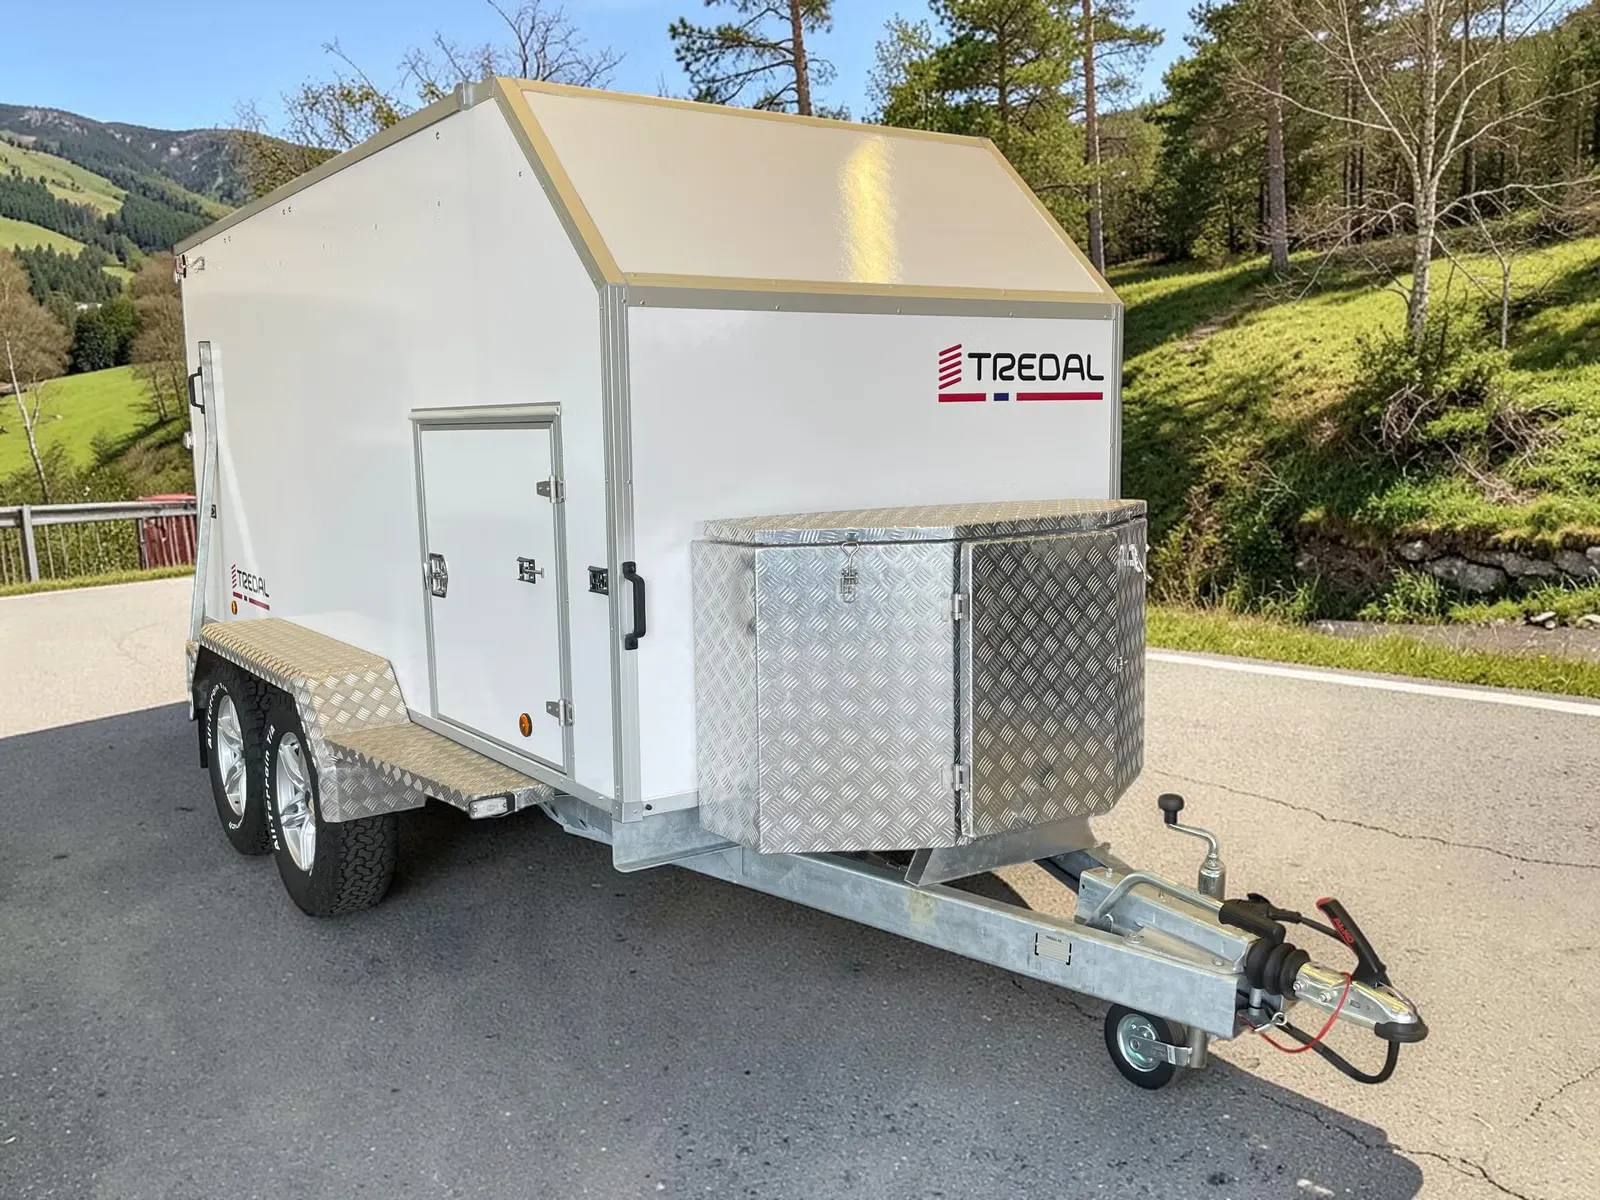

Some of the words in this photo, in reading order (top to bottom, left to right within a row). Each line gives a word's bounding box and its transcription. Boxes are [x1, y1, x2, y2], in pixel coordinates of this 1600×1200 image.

[967, 352, 1104, 381] TREDAL
[237, 569, 270, 598] TREDAL
[264, 750, 280, 850] All-Terrain
